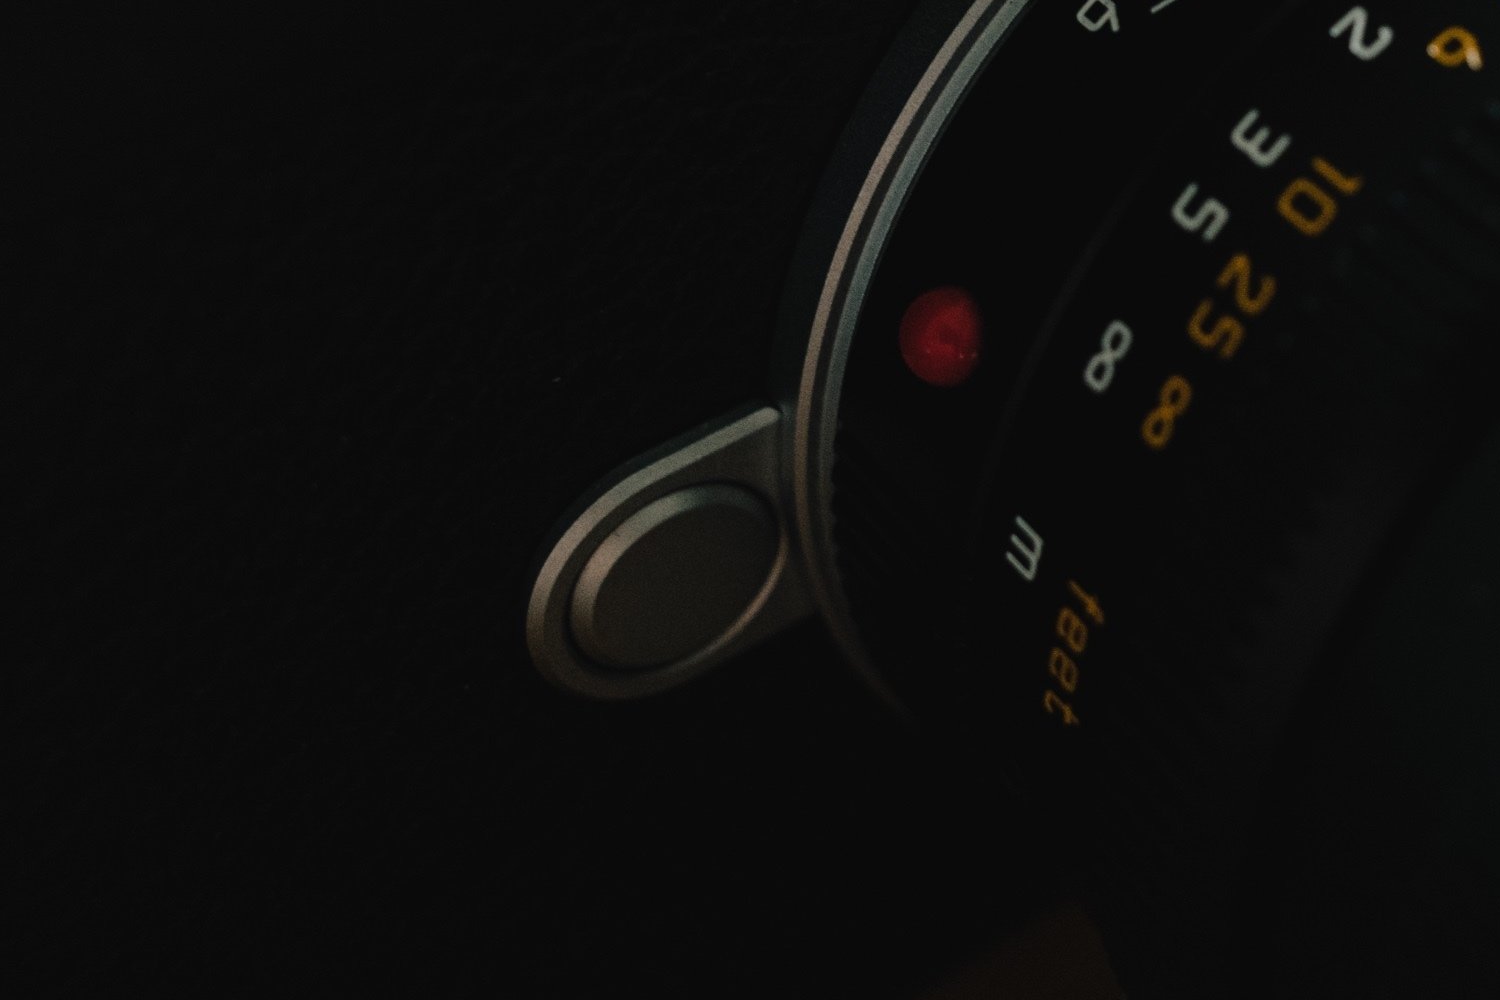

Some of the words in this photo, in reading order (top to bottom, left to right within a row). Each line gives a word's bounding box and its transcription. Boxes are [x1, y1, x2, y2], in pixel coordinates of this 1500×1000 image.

[1328, 5, 1395, 62] 2
[1425, 26, 1485, 72] 6
[1229, 108, 1293, 169] 3
[1169, 182, 1231, 243] 5
[1275, 157, 1364, 238] 10
[1187, 252, 1279, 359] 25
[1042, 579, 1106, 727] feet
